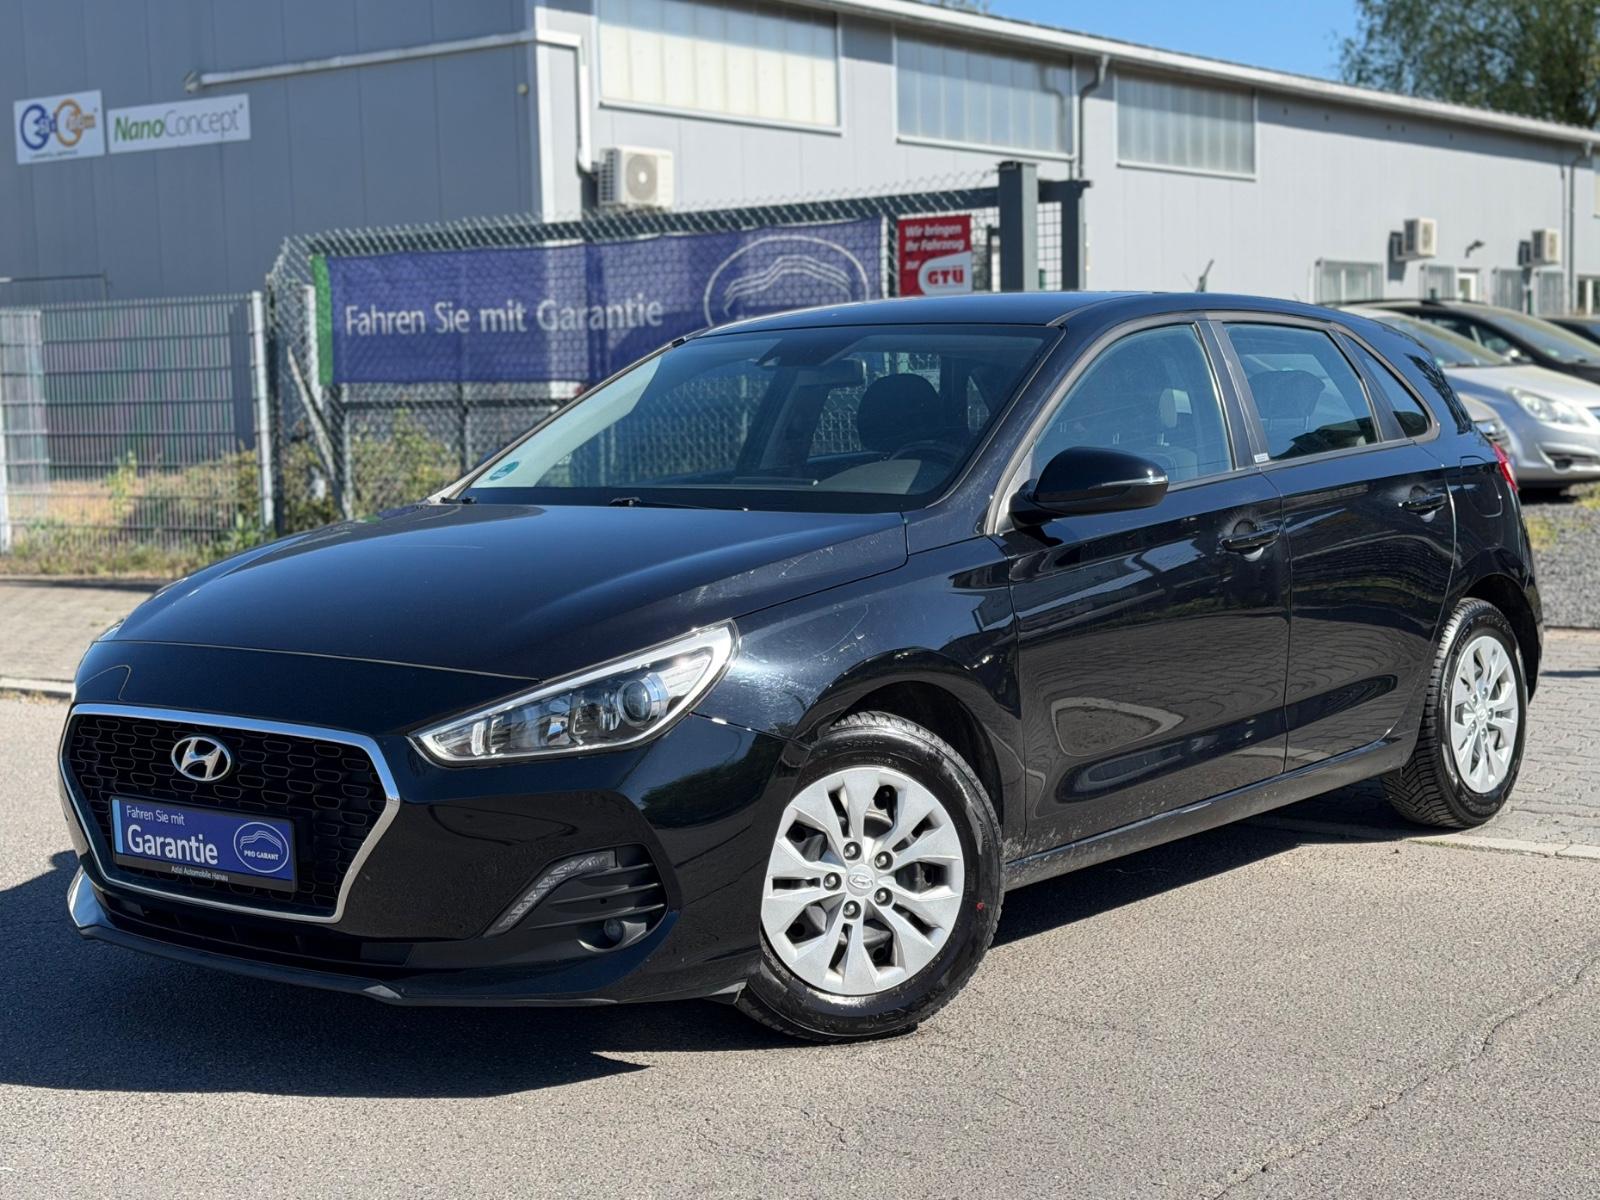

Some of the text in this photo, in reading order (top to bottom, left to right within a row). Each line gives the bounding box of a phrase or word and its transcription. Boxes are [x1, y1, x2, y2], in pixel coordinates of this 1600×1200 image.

[905, 224, 962, 238] Wir bringen
[920, 239, 965, 251] Fahrzeug
[345, 292, 664, 336] Fahren Sie mit Garantie
[126, 805, 186, 826] Fahren Sie mit
[127, 824, 219, 865] Garantie
[243, 849, 279, 861] PRO GARANT
